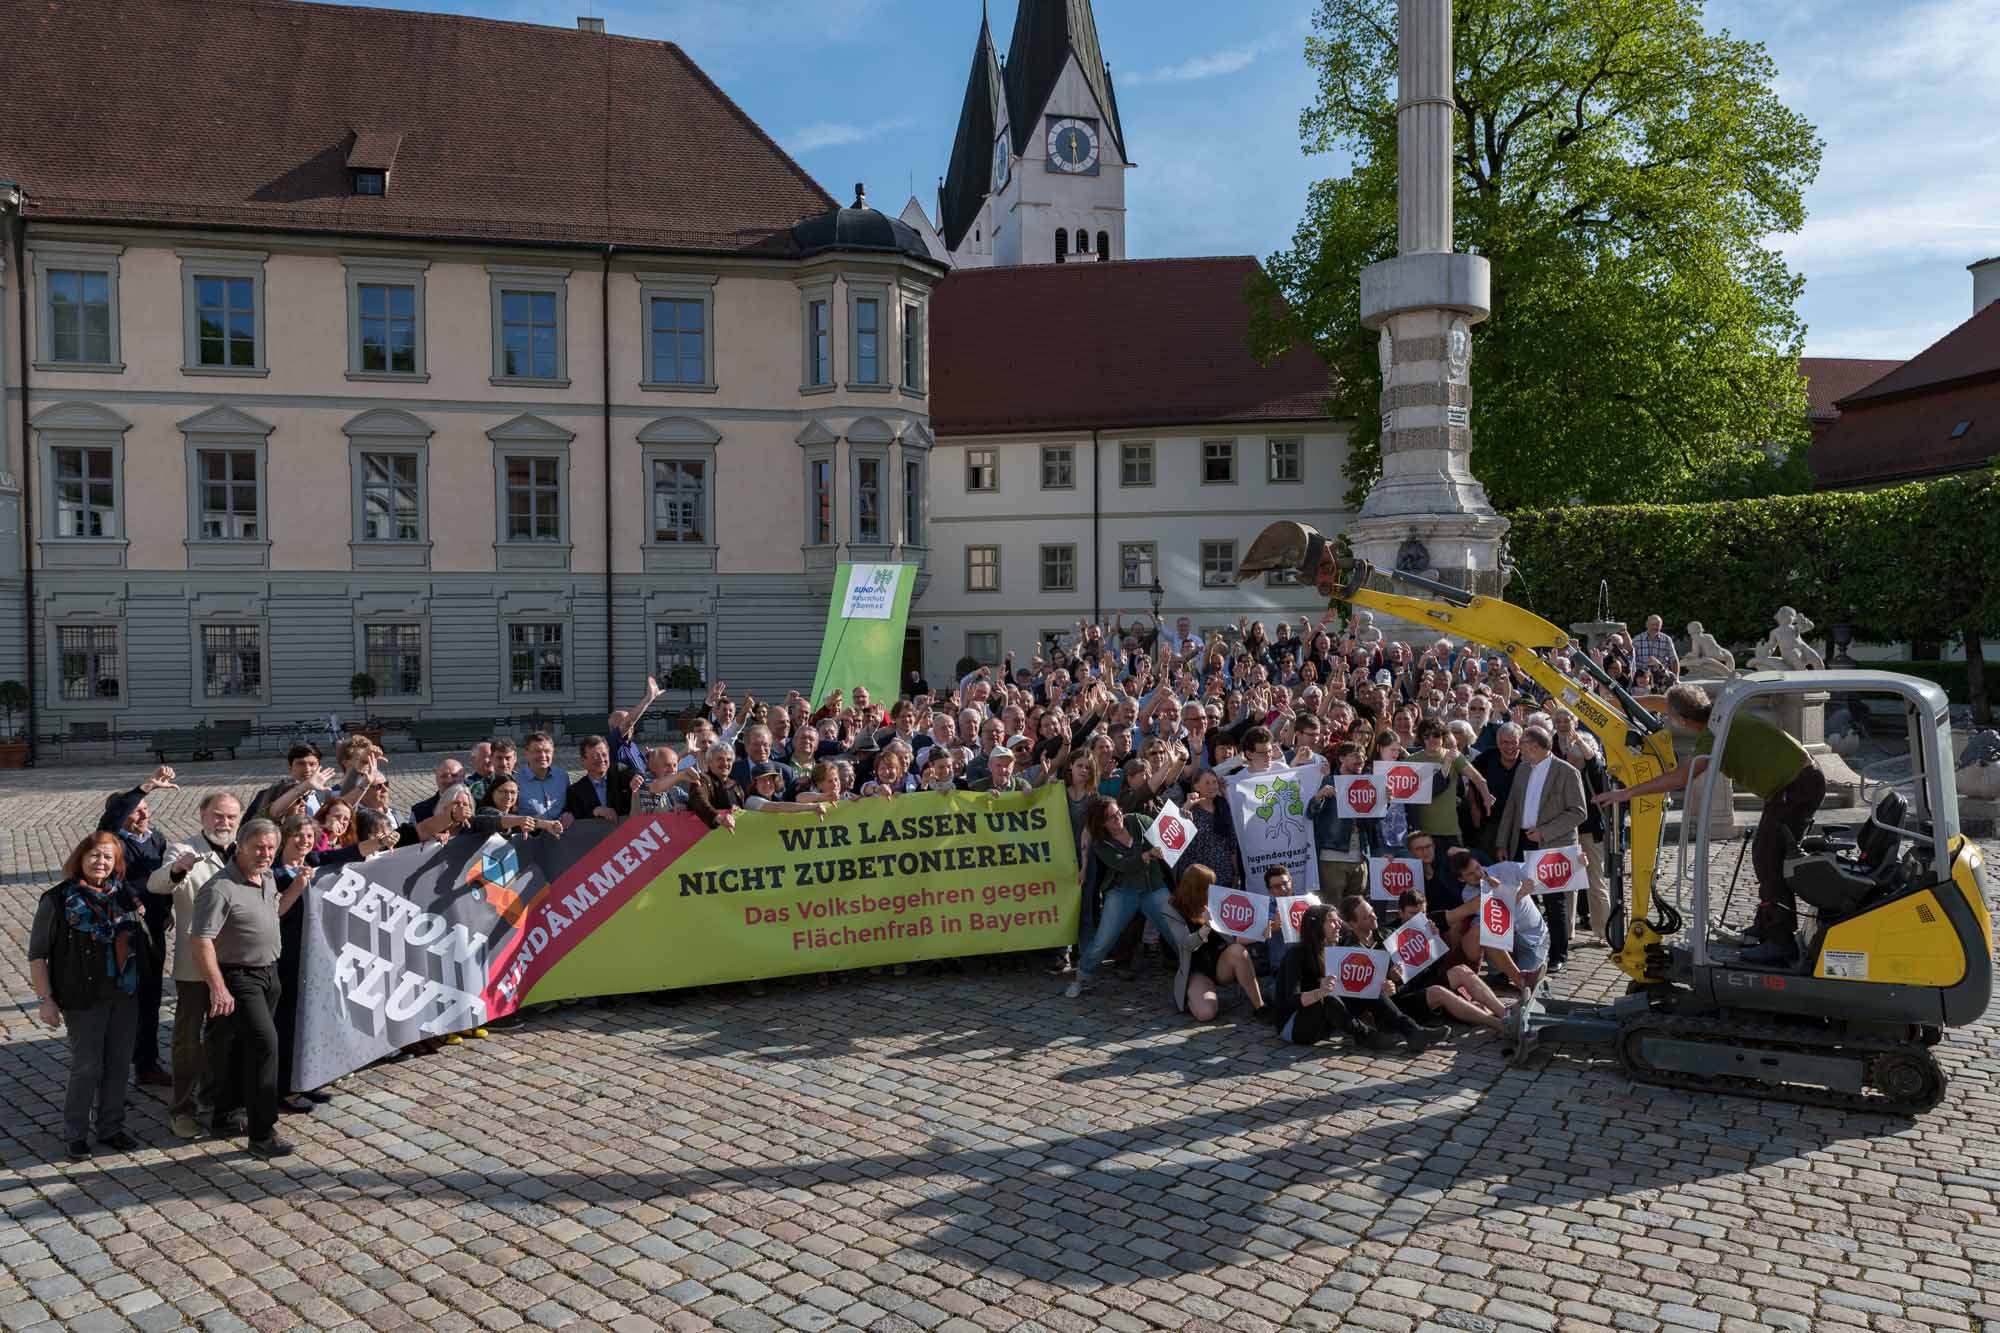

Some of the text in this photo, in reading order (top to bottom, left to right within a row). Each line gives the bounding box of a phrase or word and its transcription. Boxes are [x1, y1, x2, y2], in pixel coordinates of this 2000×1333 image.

[1350, 789, 1375, 803] STOP
[1388, 776, 1416, 789] STOP
[778, 808, 1048, 851] WIR LASSEN UNS
[1162, 818, 1184, 846] STOP
[678, 841, 1052, 896] NICHT ZUBETONIEREN!
[1384, 872, 1411, 886] STOP
[1537, 862, 1569, 879] STOP
[323, 868, 488, 963] BETON
[497, 820, 672, 1001] EINDÄMMEN!
[745, 880, 1056, 925] Das Volksbegehren gegen
[1222, 904, 1251, 922] STOP
[1491, 900, 1502, 932] STOP
[792, 905, 1059, 950] Flächenfraß in Bayern!
[1292, 912, 1306, 927] ST
[1400, 935, 1425, 961] STOP
[1343, 966, 1373, 981] STOP
[334, 943, 486, 1035] FLUT
